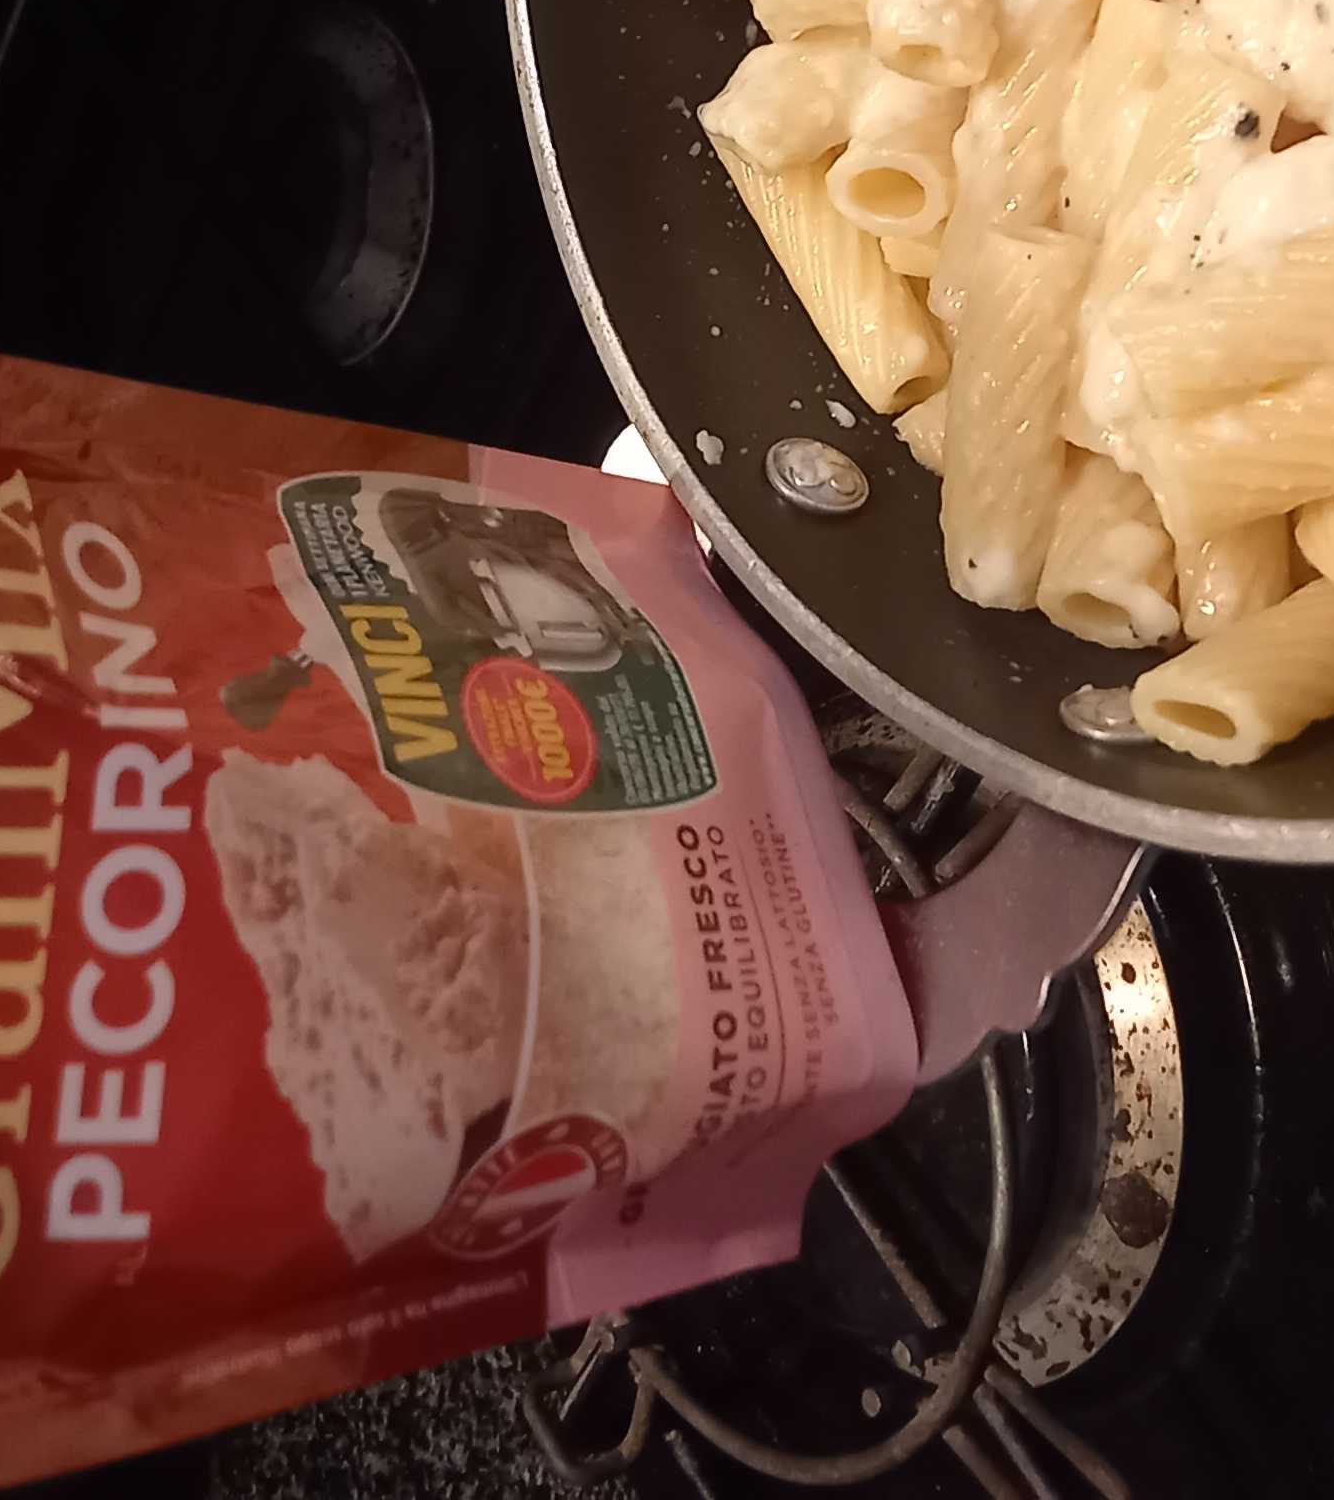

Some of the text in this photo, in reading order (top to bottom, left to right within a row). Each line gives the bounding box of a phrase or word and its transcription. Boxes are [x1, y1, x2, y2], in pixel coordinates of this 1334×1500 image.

[332, 505, 391, 598] KENWOOD
[337, 602, 459, 763] VINCI
[515, 677, 574, 782] 1000€
[45, 520, 195, 1245] PECORINO
[674, 823, 734, 995] FRESCO
[705, 824, 770, 1053] EQUILIBRATO
[787, 956, 822, 1042] SENZA
[802, 940, 840, 1027] SENZA
